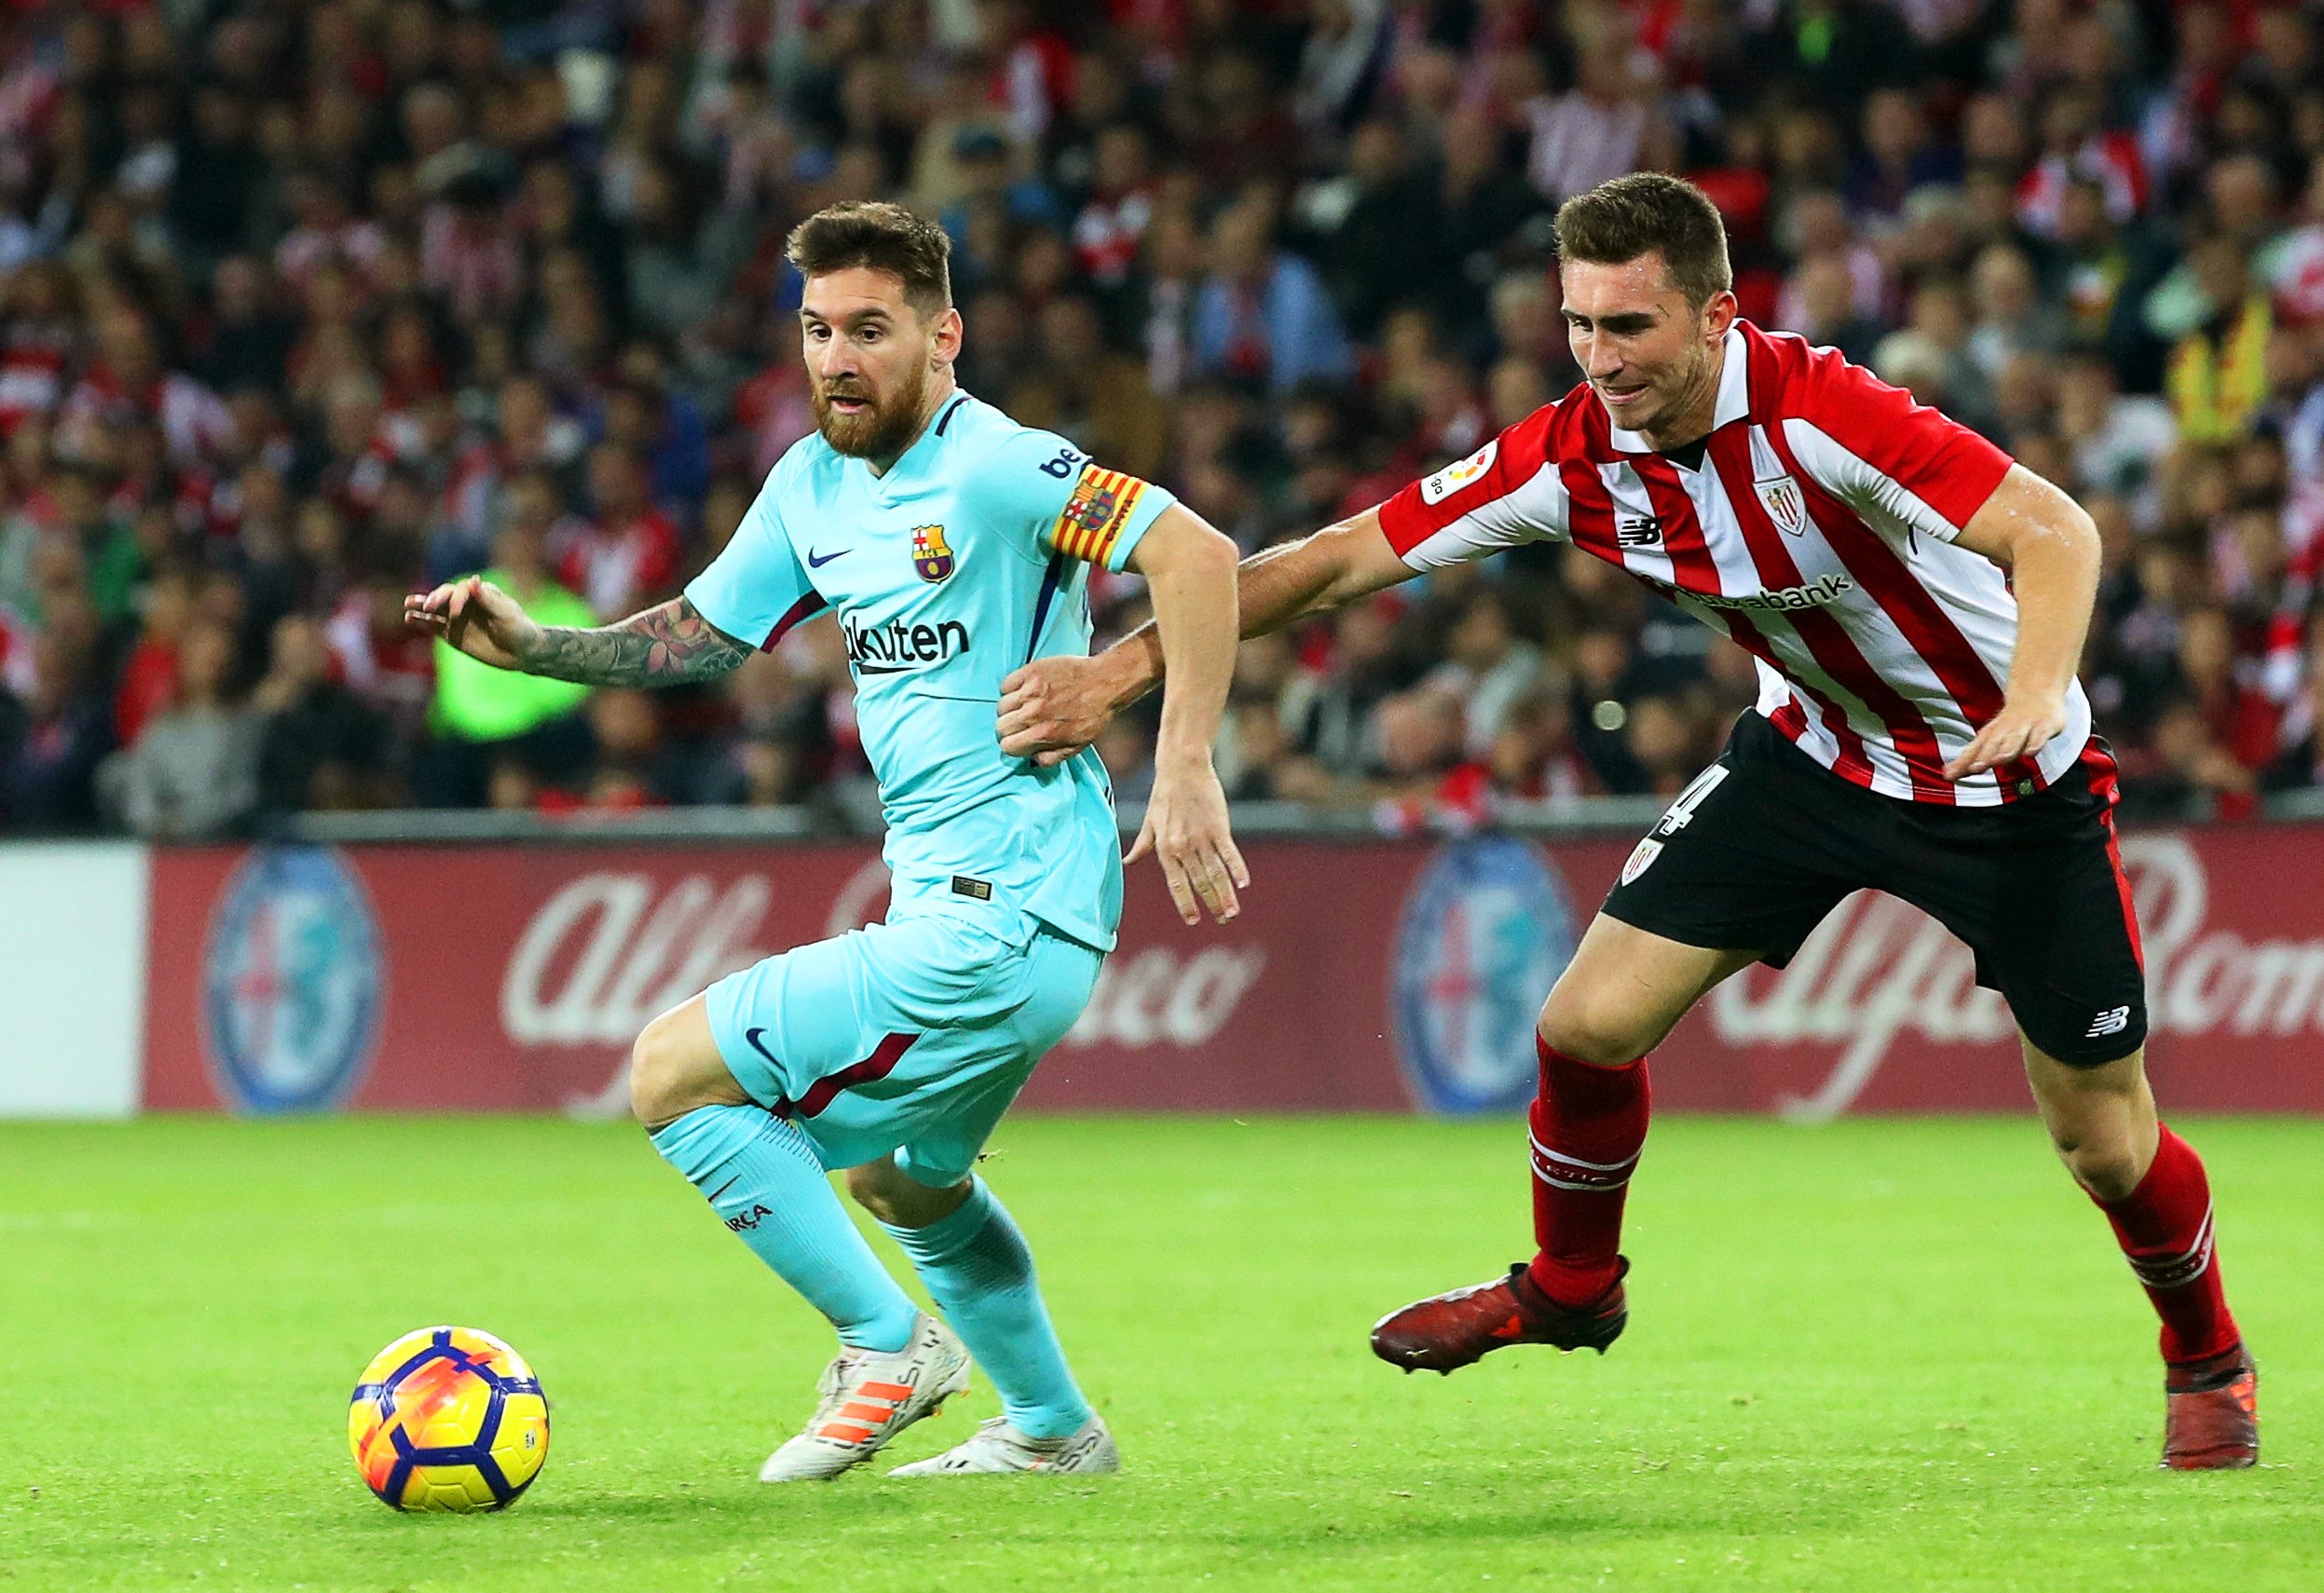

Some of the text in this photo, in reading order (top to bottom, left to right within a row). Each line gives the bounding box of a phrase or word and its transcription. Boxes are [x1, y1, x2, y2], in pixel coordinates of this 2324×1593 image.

[1038, 448, 1082, 479] be
[1673, 575, 1851, 610] utxabank
[843, 615, 970, 662] akuten
[497, 871, 792, 1123] Alf
[724, 1204, 773, 1232] RÇA
